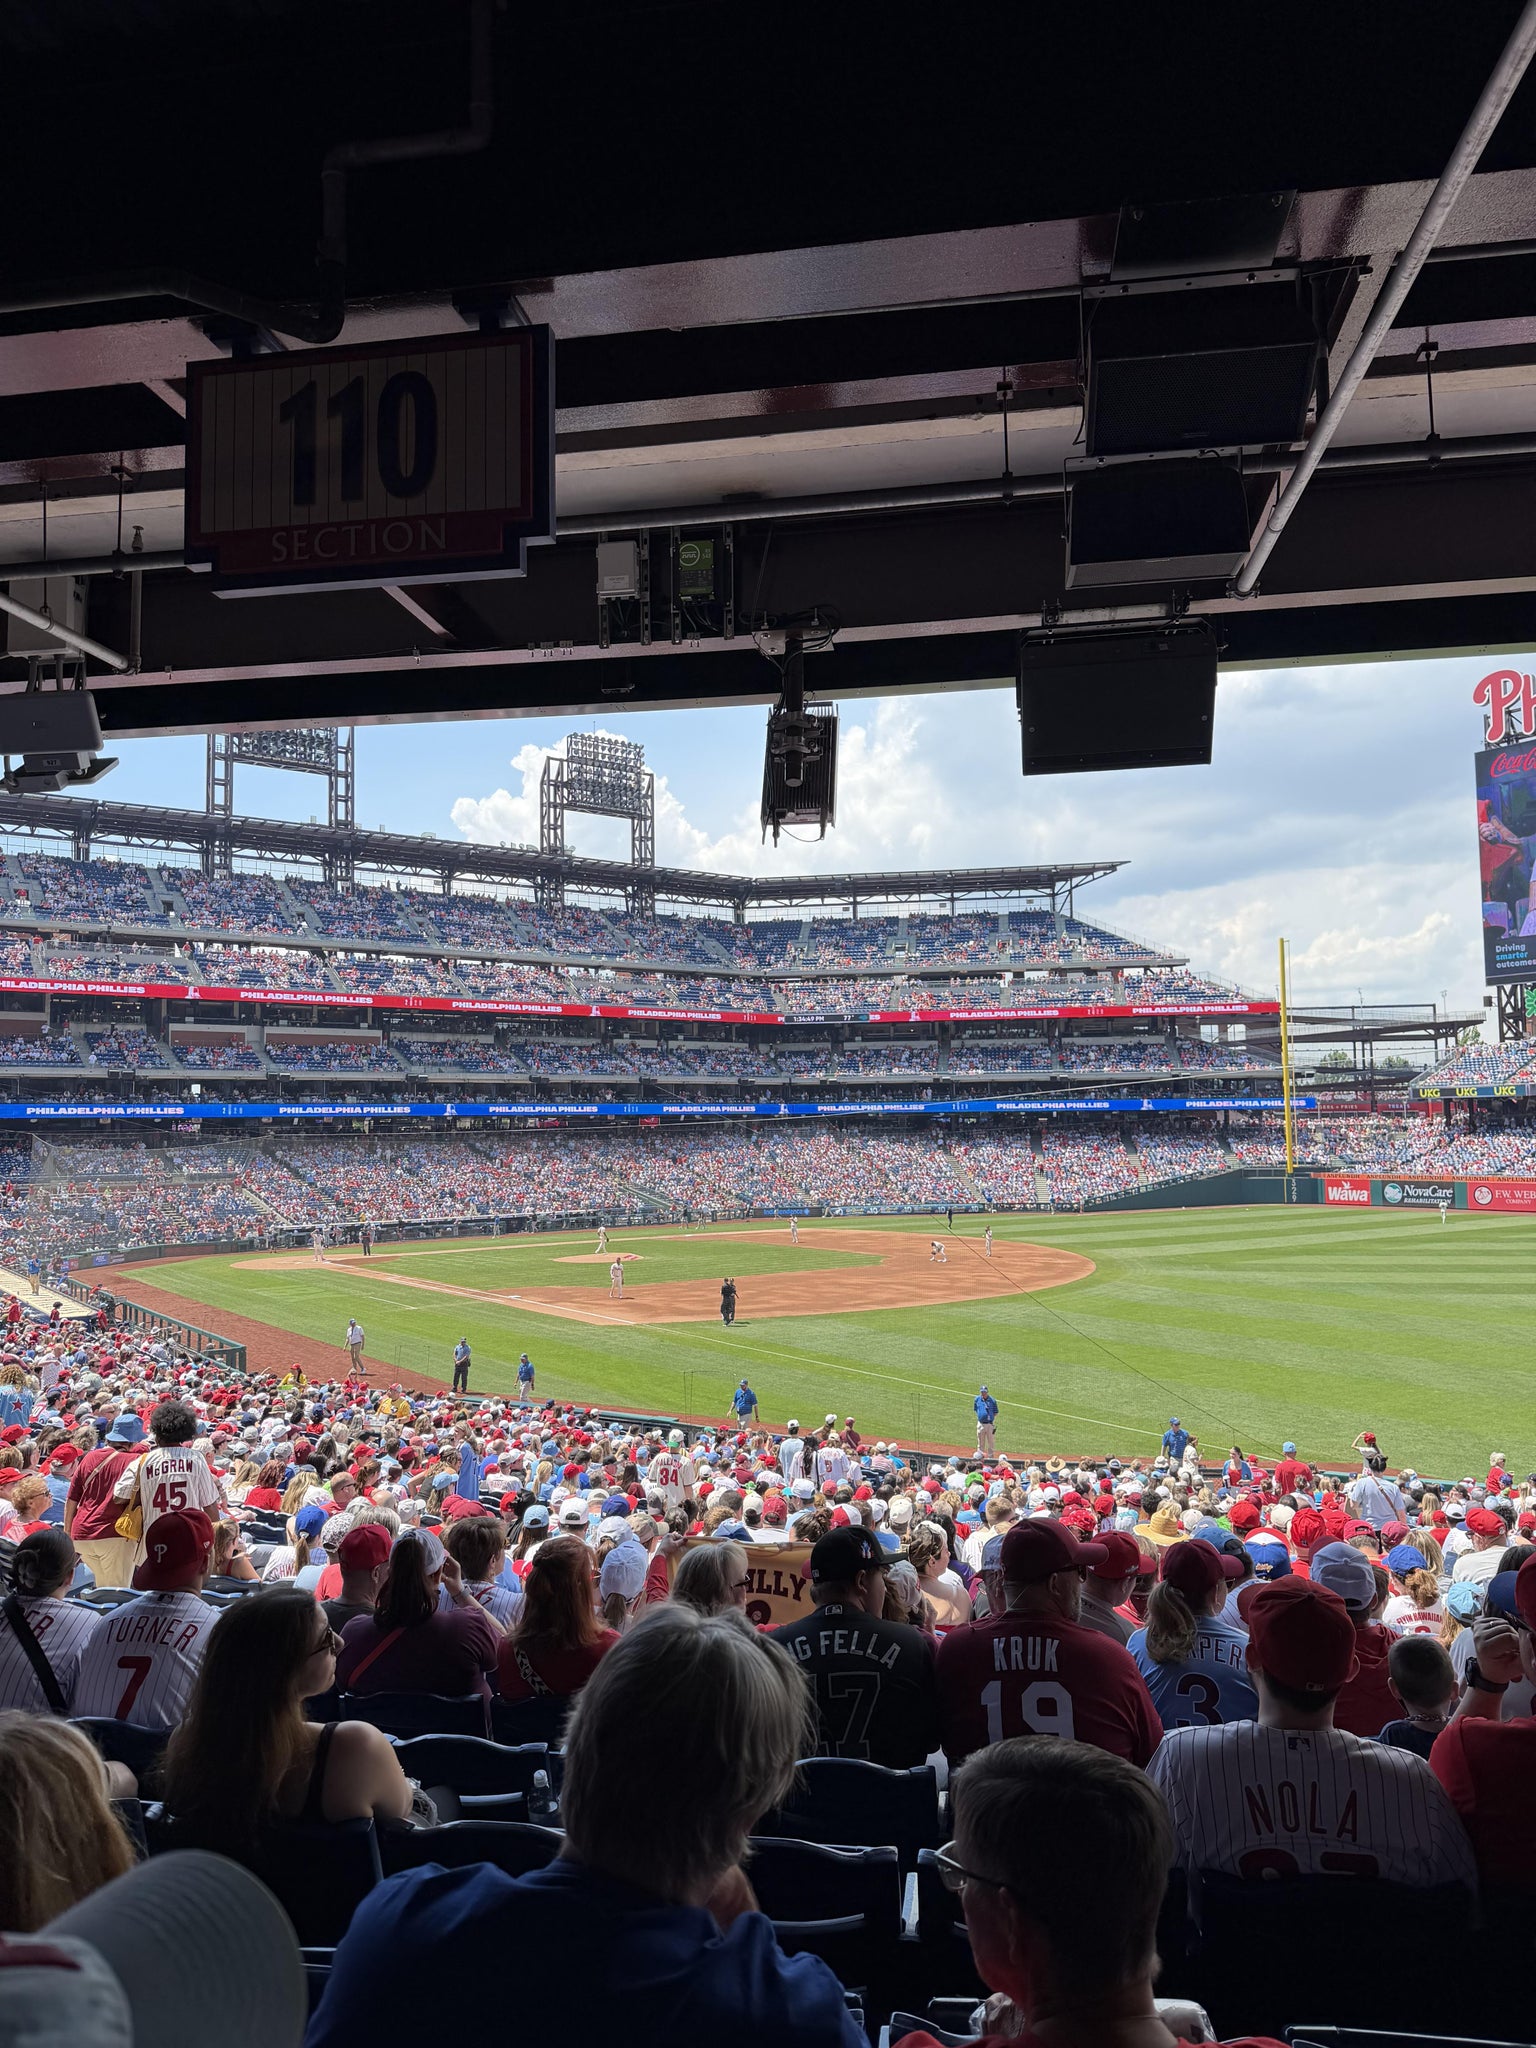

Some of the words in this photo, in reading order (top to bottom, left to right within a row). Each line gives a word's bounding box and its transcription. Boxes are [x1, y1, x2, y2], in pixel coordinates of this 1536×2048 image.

[279, 371, 437, 506] 110
[271, 517, 448, 563] SECTION
[1495, 943, 1526, 953] Driving
[1495, 952, 1529, 961] smarter
[88, 984, 145, 994] PHILLIES
[240, 991, 326, 1002] PHILADELPHIA
[326, 995, 374, 1004] PHILLIES
[452, 1001, 521, 1010] PHILADELPHIA
[521, 1005, 562, 1013] PHILLIES
[1133, 1005, 1204, 1014] PHILADELPHIA
[1204, 1004, 1249, 1012] PHILLIES
[628, 1009, 686, 1018] PHILADELPHIA
[687, 1012, 721, 1020] PHILLIES
[950, 1010, 1017, 1018] PHILADELPHIA
[1419, 1088, 1441, 1098] UKG
[1455, 1087, 1478, 1097] UKG
[1493, 1086, 1517, 1096] UKG
[489, 1105, 558, 1113] PHILADELPHIA
[558, 1105, 598, 1113] PHILLIES
[663, 1105, 721, 1113] PHILADELPHIA
[818, 1104, 883, 1112] PHILADELPHIA
[884, 1103, 925, 1111] PHILLIES
[1186, 1100, 1260, 1108] PHILADELPHIA
[1260, 1099, 1307, 1107] PHILIES
[27, 1107, 125, 1115] PHILADELPHIA
[126, 1107, 185, 1115] PHILLIES
[280, 1106, 362, 1114] PHILADELPHIA
[363, 1106, 411, 1114] PHILLIES
[1327, 1186, 1368, 1202] Wawa
[1403, 1185, 1453, 1198] NovaCare
[146, 1459, 193, 1480] McGRAW
[660, 1467, 679, 1487] 34
[153, 1481, 188, 1513] 45
[154, 1543, 168, 1564] P
[107, 1615, 199, 1652] TURNER
[819, 1629, 902, 1670] FELLA
[993, 1635, 1060, 1673] KRUK
[115, 1656, 152, 1721] 7
[1176, 1672, 1224, 1731] 3
[980, 1680, 1075, 1745] 19
[1245, 1780, 1357, 1843] NOLA
